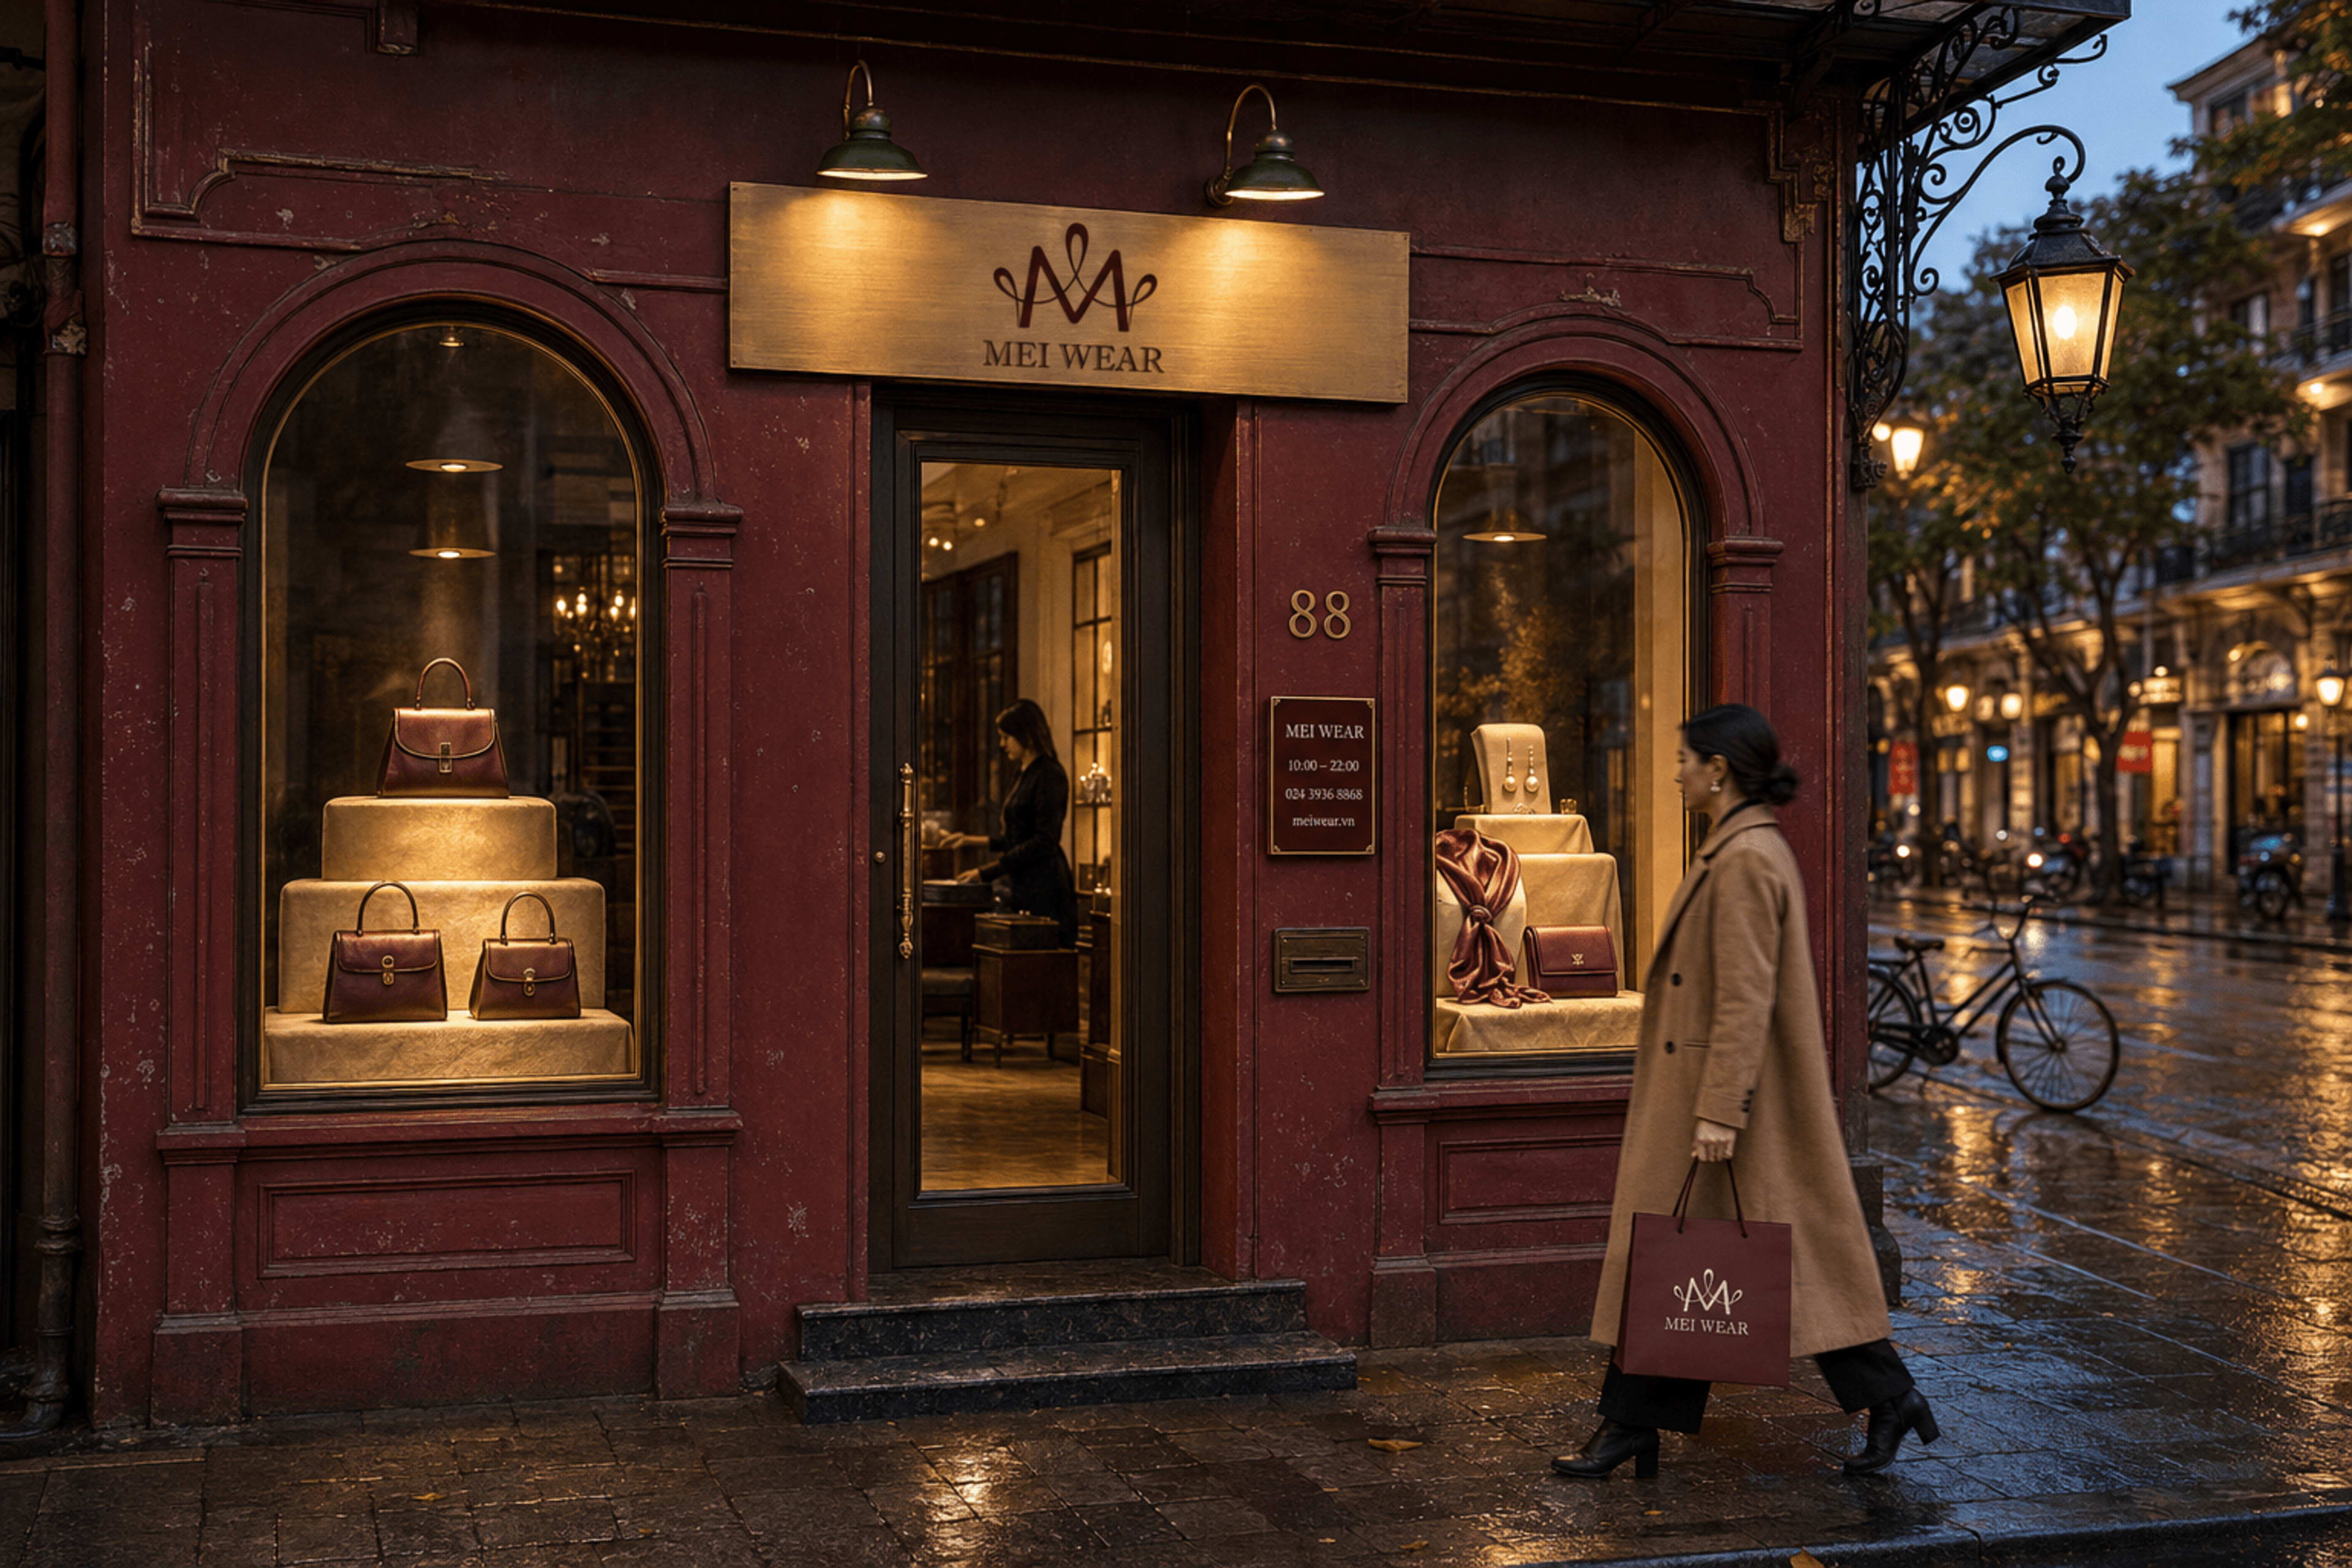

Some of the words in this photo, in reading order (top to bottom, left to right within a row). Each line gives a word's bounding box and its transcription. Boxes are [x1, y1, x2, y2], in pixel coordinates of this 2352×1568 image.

[983, 339, 1050, 368] MEI
[1058, 343, 1165, 374] WEAR
[1289, 589, 1351, 639] 88
[1286, 724, 1315, 739] MEI
[1318, 724, 1365, 739] WEAR
[1289, 760, 1317, 772] 10:00
[1330, 760, 1360, 772] 22:00
[1285, 788, 1306, 800] 024
[1308, 788, 1335, 800] 3936
[1292, 814, 1355, 827] meiwear.vn
[1664, 1317, 1696, 1332] MEI
[1700, 1319, 1749, 1336] WEAR
